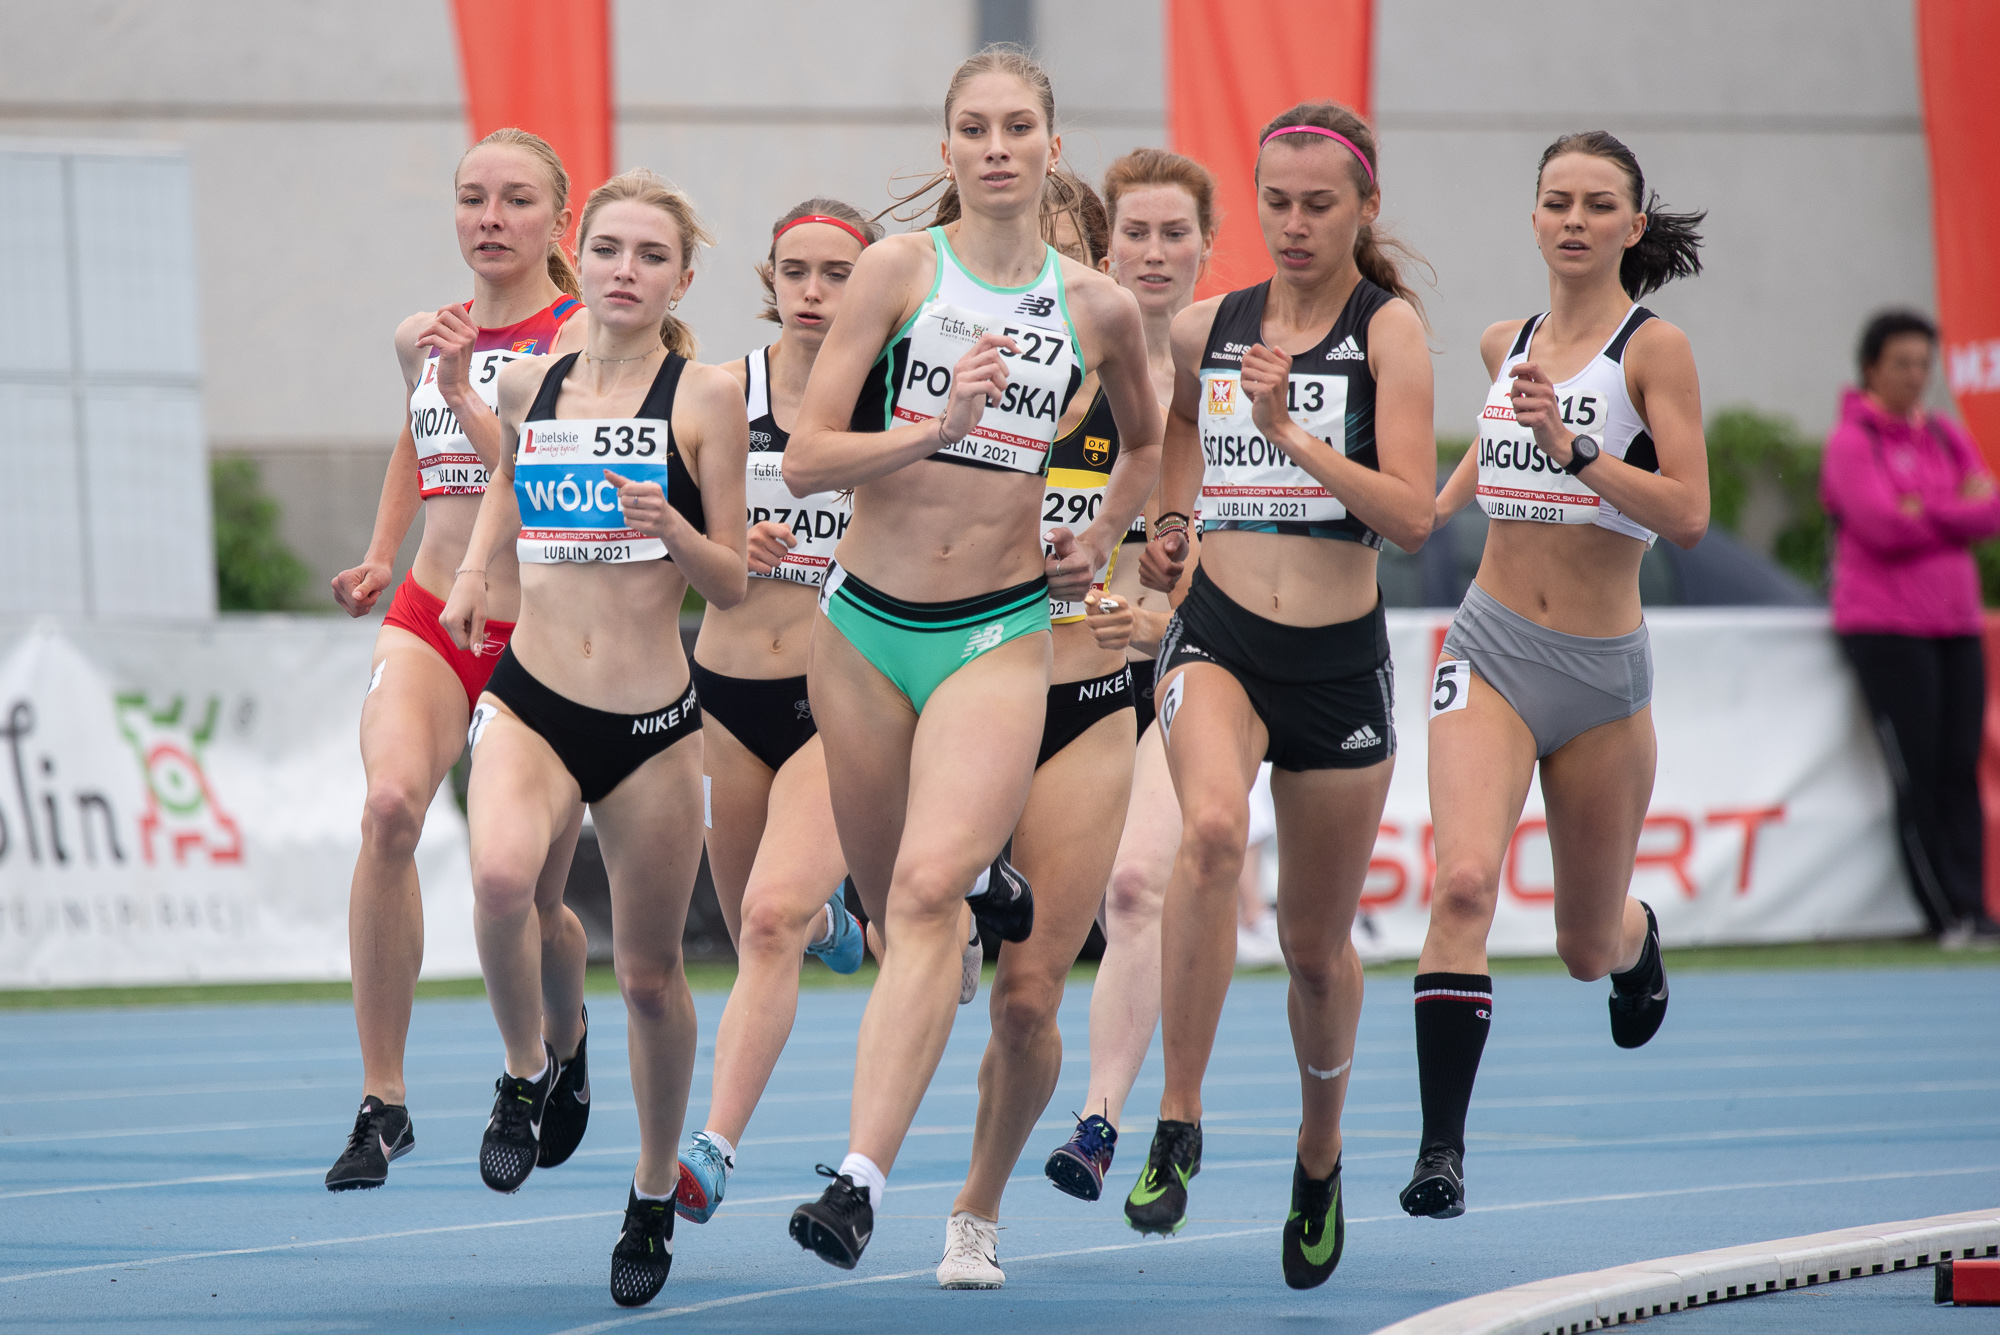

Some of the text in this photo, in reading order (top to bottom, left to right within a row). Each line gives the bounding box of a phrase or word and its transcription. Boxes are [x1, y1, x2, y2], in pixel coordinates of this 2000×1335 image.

[936, 316, 971, 337] lublin
[1000, 327, 1064, 366] 527
[1325, 348, 1365, 361] adidas
[906, 360, 1056, 423] POSKA
[1484, 409, 1516, 420] ORLEN
[1556, 396, 1597, 426] 15
[593, 426, 657, 457] 535
[900, 410, 912, 419] 75.
[1000, 434, 1030, 447] POLSKI
[1031, 441, 1049, 451] U20
[981, 444, 1017, 465] 2021
[1203, 429, 1334, 468] ŚCISŁOW
[1479, 438, 1571, 476] JAGUSC
[525, 473, 652, 512] WÓJC
[1223, 488, 1285, 496] MISTRZOSTWA
[1494, 489, 1546, 500] MISTRZOSTWA
[1546, 494, 1576, 503] POLSKI
[1043, 492, 1103, 523] 290
[1217, 503, 1307, 517] LUBLIN 2021
[1488, 501, 1564, 521] LUBLIN 2021
[555, 532, 608, 540] MISTRZOSTWA
[544, 546, 631, 560] LUBLIN 2021
[1078, 674, 1125, 701] NIKE
[1434, 664, 1457, 711] 5
[632, 707, 680, 735] NIKE
[1163, 688, 1176, 731] 6
[1341, 736, 1382, 750] adidas
[0, 699, 126, 866] lin
[1358, 802, 1788, 907] SORT
